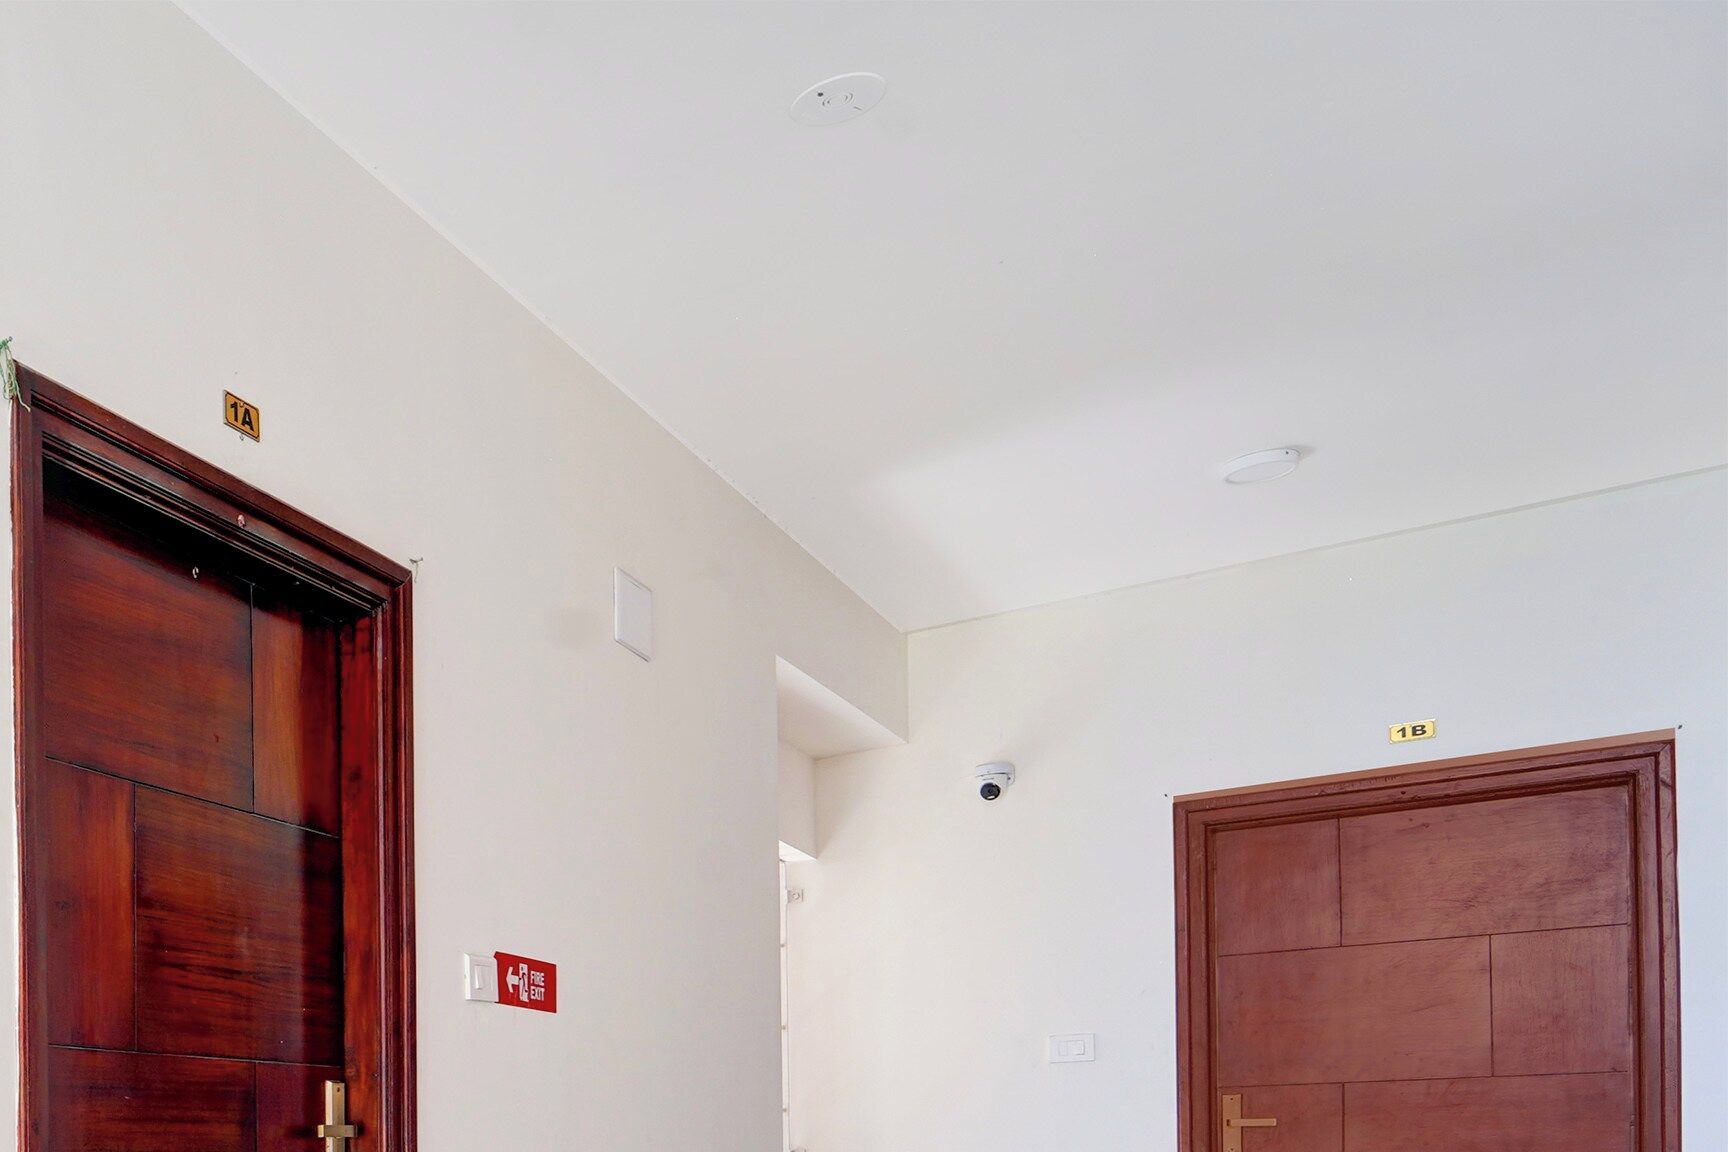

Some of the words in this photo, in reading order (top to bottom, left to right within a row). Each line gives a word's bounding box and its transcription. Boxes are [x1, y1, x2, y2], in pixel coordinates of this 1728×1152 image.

[230, 401, 254, 431] 1A
[1396, 724, 1427, 738] 1B
[530, 971, 545, 986] FIRE
[530, 986, 545, 1001] EXIT
